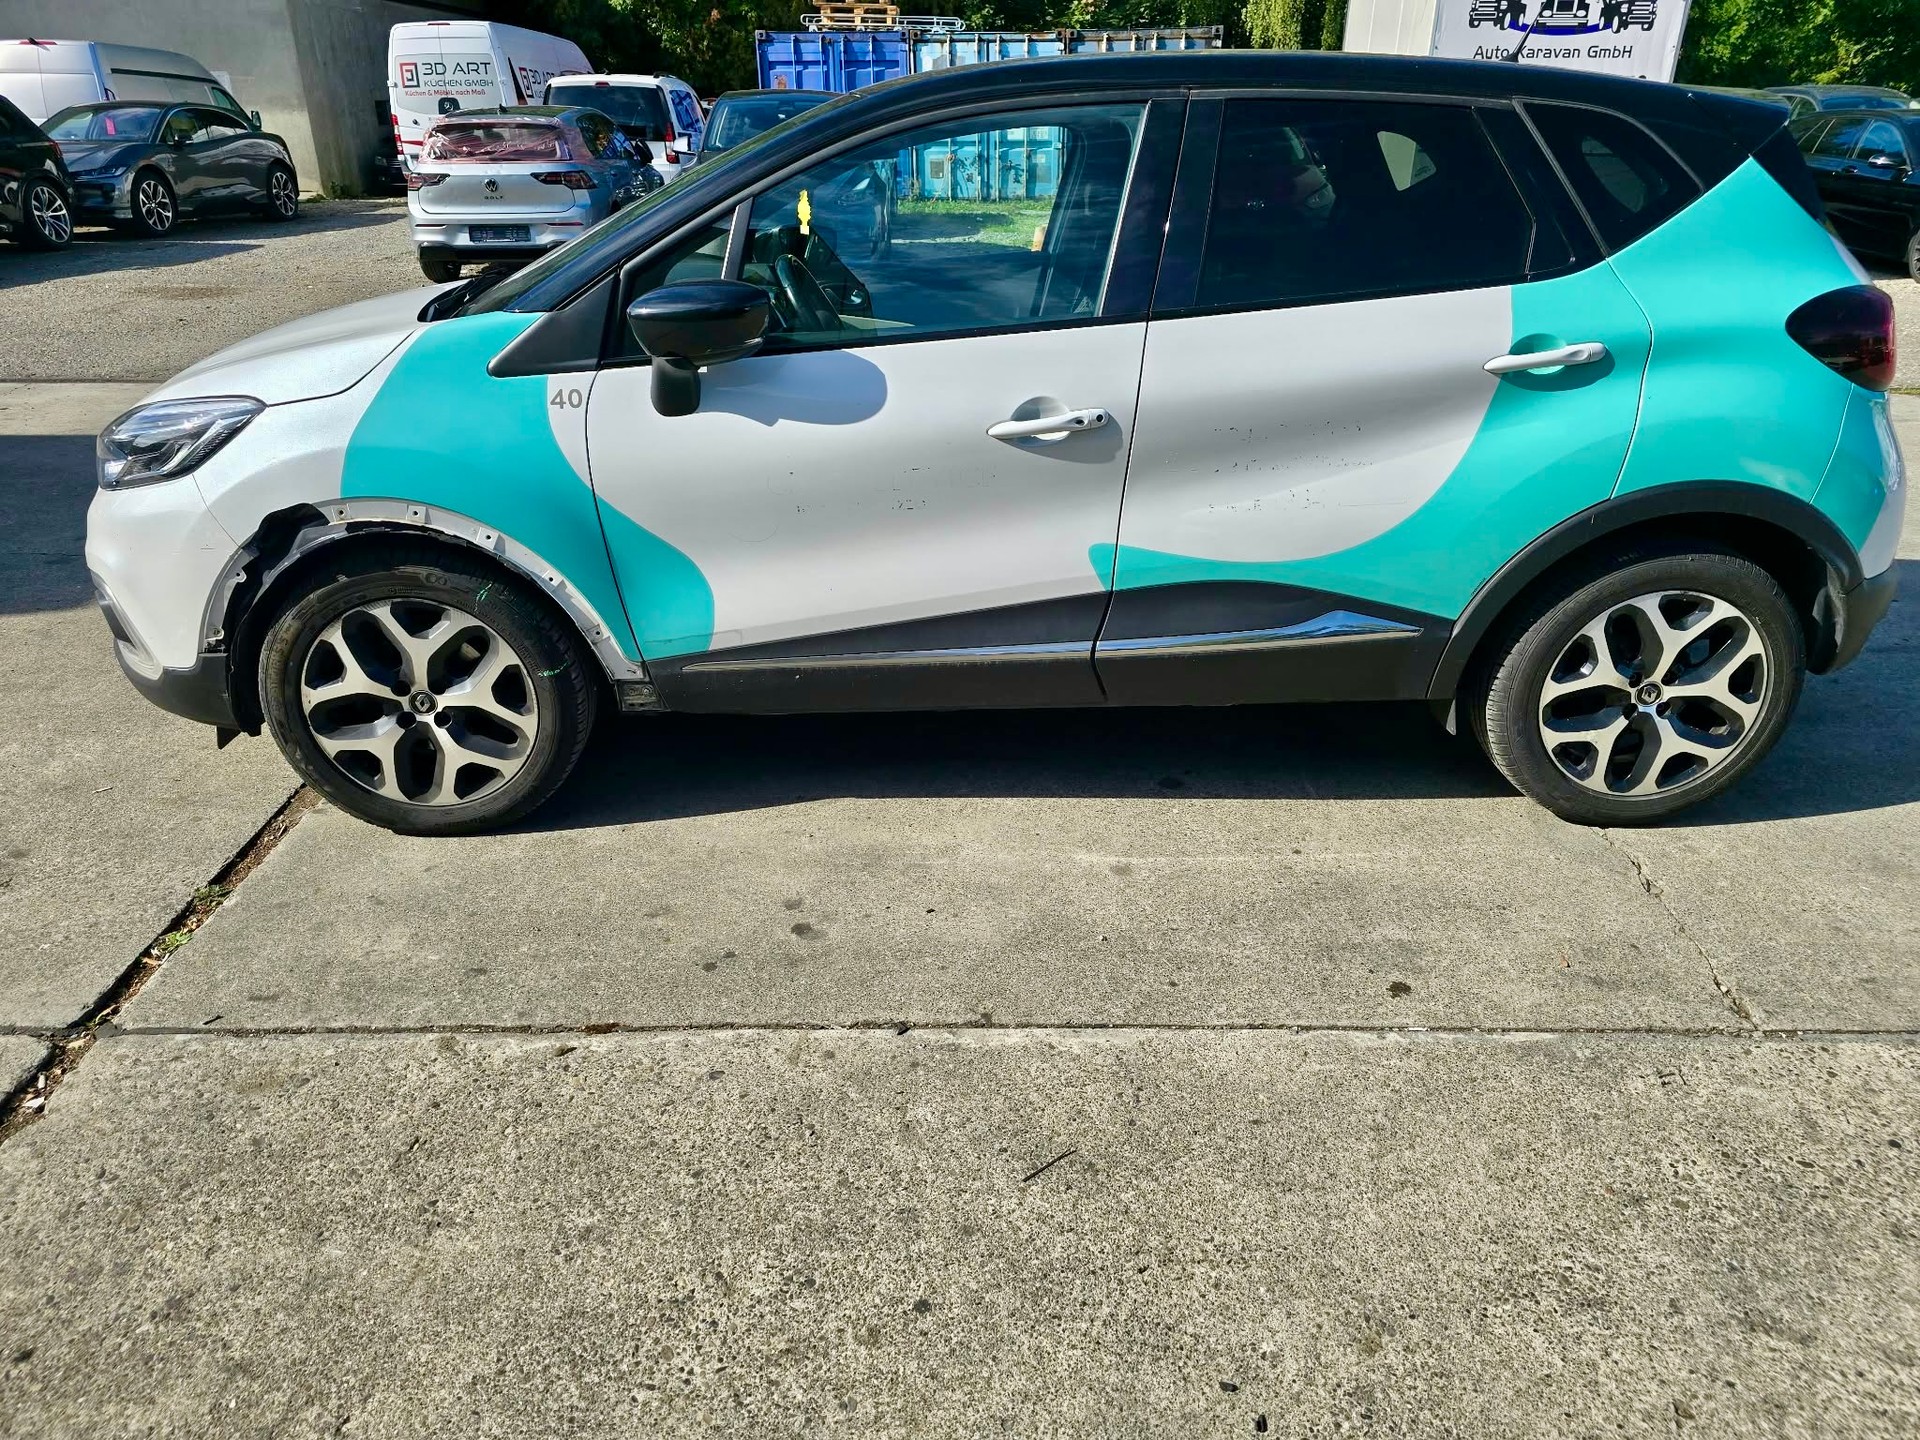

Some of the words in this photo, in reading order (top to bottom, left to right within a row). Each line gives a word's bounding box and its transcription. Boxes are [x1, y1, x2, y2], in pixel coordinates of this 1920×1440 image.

[1473, 45, 1510, 60] Auto
[1587, 45, 1633, 59] GmbH
[421, 62, 447, 75] 3D
[452, 62, 491, 75] ART
[528, 68, 542, 84] 3D
[550, 388, 583, 409] 40
